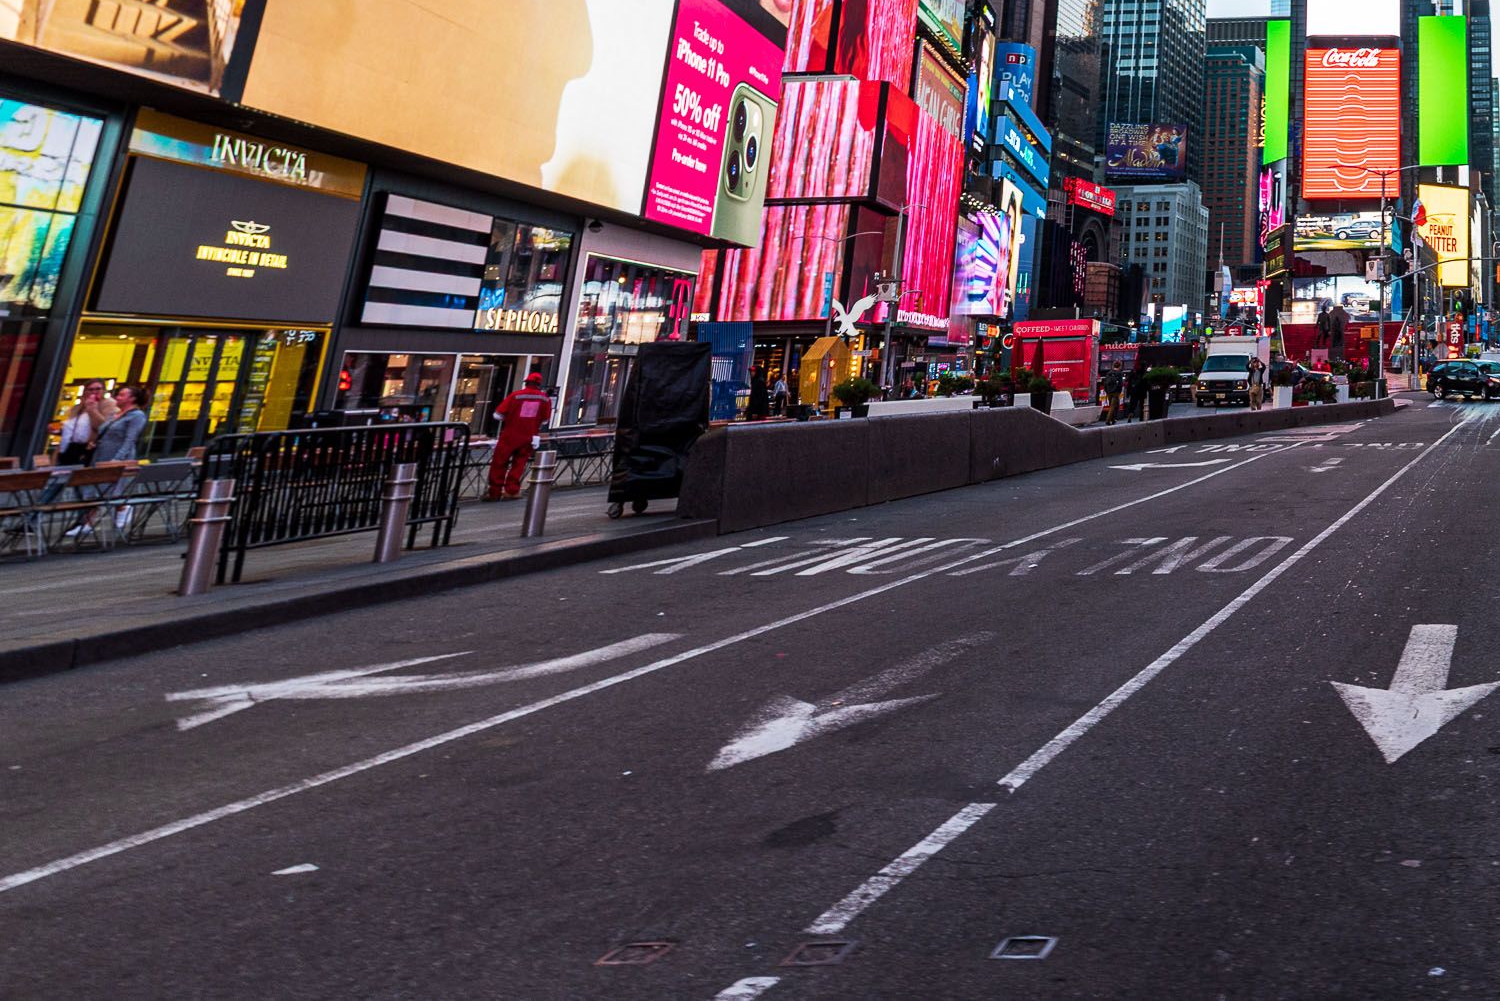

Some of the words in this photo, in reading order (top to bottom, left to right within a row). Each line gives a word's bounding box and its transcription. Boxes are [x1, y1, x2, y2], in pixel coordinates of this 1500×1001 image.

[694, 20, 710, 45] Trade
[709, 36, 718, 52] up
[717, 40, 724, 55] to
[677, 37, 707, 74] iPhone
[707, 57, 716, 79] 11
[715, 62, 730, 88] Pro
[1322, 47, 1381, 68] Coca-Cola
[673, 82, 703, 124] 50%
[703, 103, 722, 133] off
[1109, 122, 1149, 130] DAZZLING
[210, 133, 309, 181] INVICTA
[225, 230, 271, 248] INVICTA
[1429, 223, 1453, 236] PEANUT
[485, 307, 560, 333] SEPHORA
[1016, 325, 1051, 334] COFFEED
[1451, 323, 1459, 344] tkts
